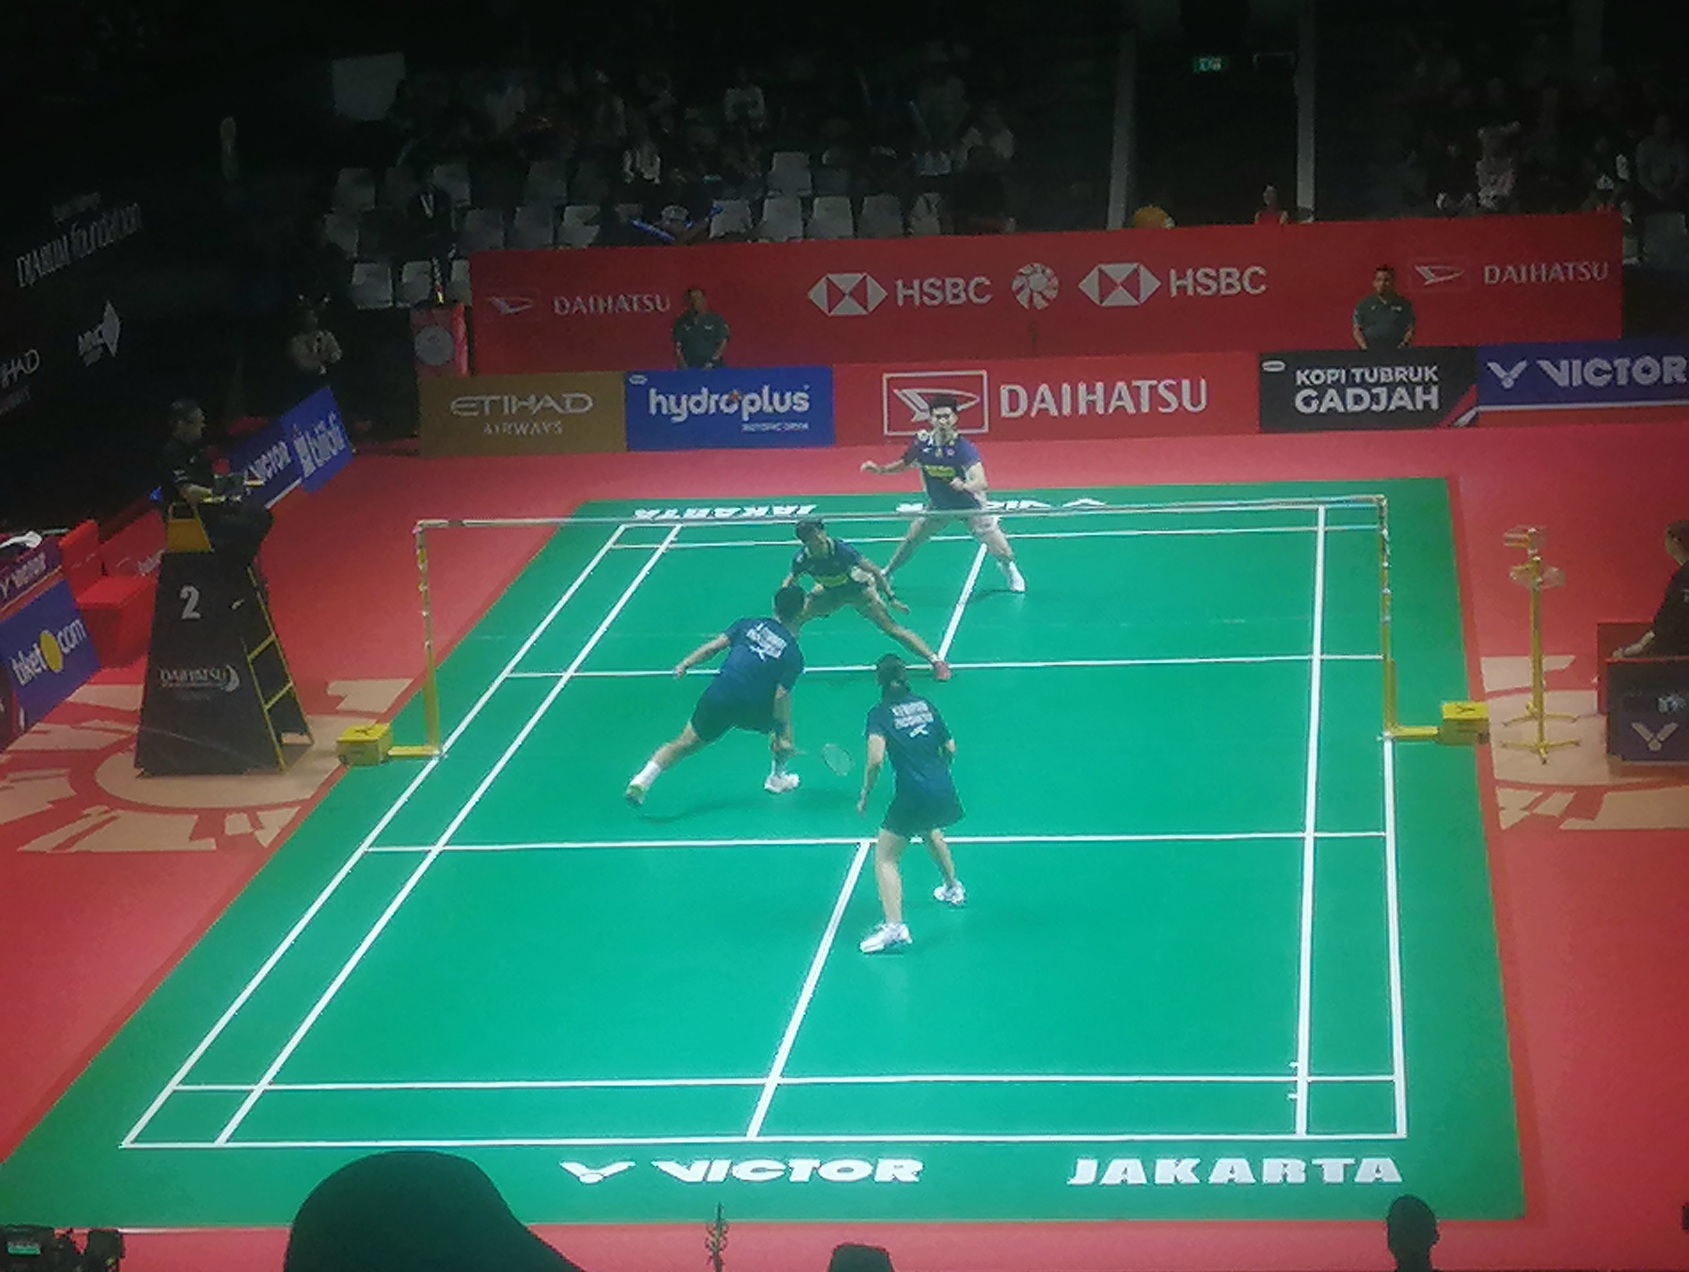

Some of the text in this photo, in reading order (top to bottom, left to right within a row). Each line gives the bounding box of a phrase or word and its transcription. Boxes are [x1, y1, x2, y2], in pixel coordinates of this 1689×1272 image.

[1169, 266, 1268, 297] HSBC
[1484, 260, 1609, 285] DAIHATSU
[554, 293, 671, 316] DAIHATSU
[896, 276, 993, 307] HSBC
[1295, 364, 1440, 386] KOPI TUBRUK
[1536, 354, 1689, 388] VICTOR
[450, 392, 594, 416] ETIHAD
[649, 384, 811, 423] hydroplus
[1000, 377, 1208, 418] DAIHATSU
[1294, 384, 1440, 415] GADJAH
[483, 420, 563, 435] AIRWAYS
[180, 584, 202, 620] 2
[651, 1157, 924, 1184] VICTOR
[1067, 1157, 1402, 1185] JAKARTA
